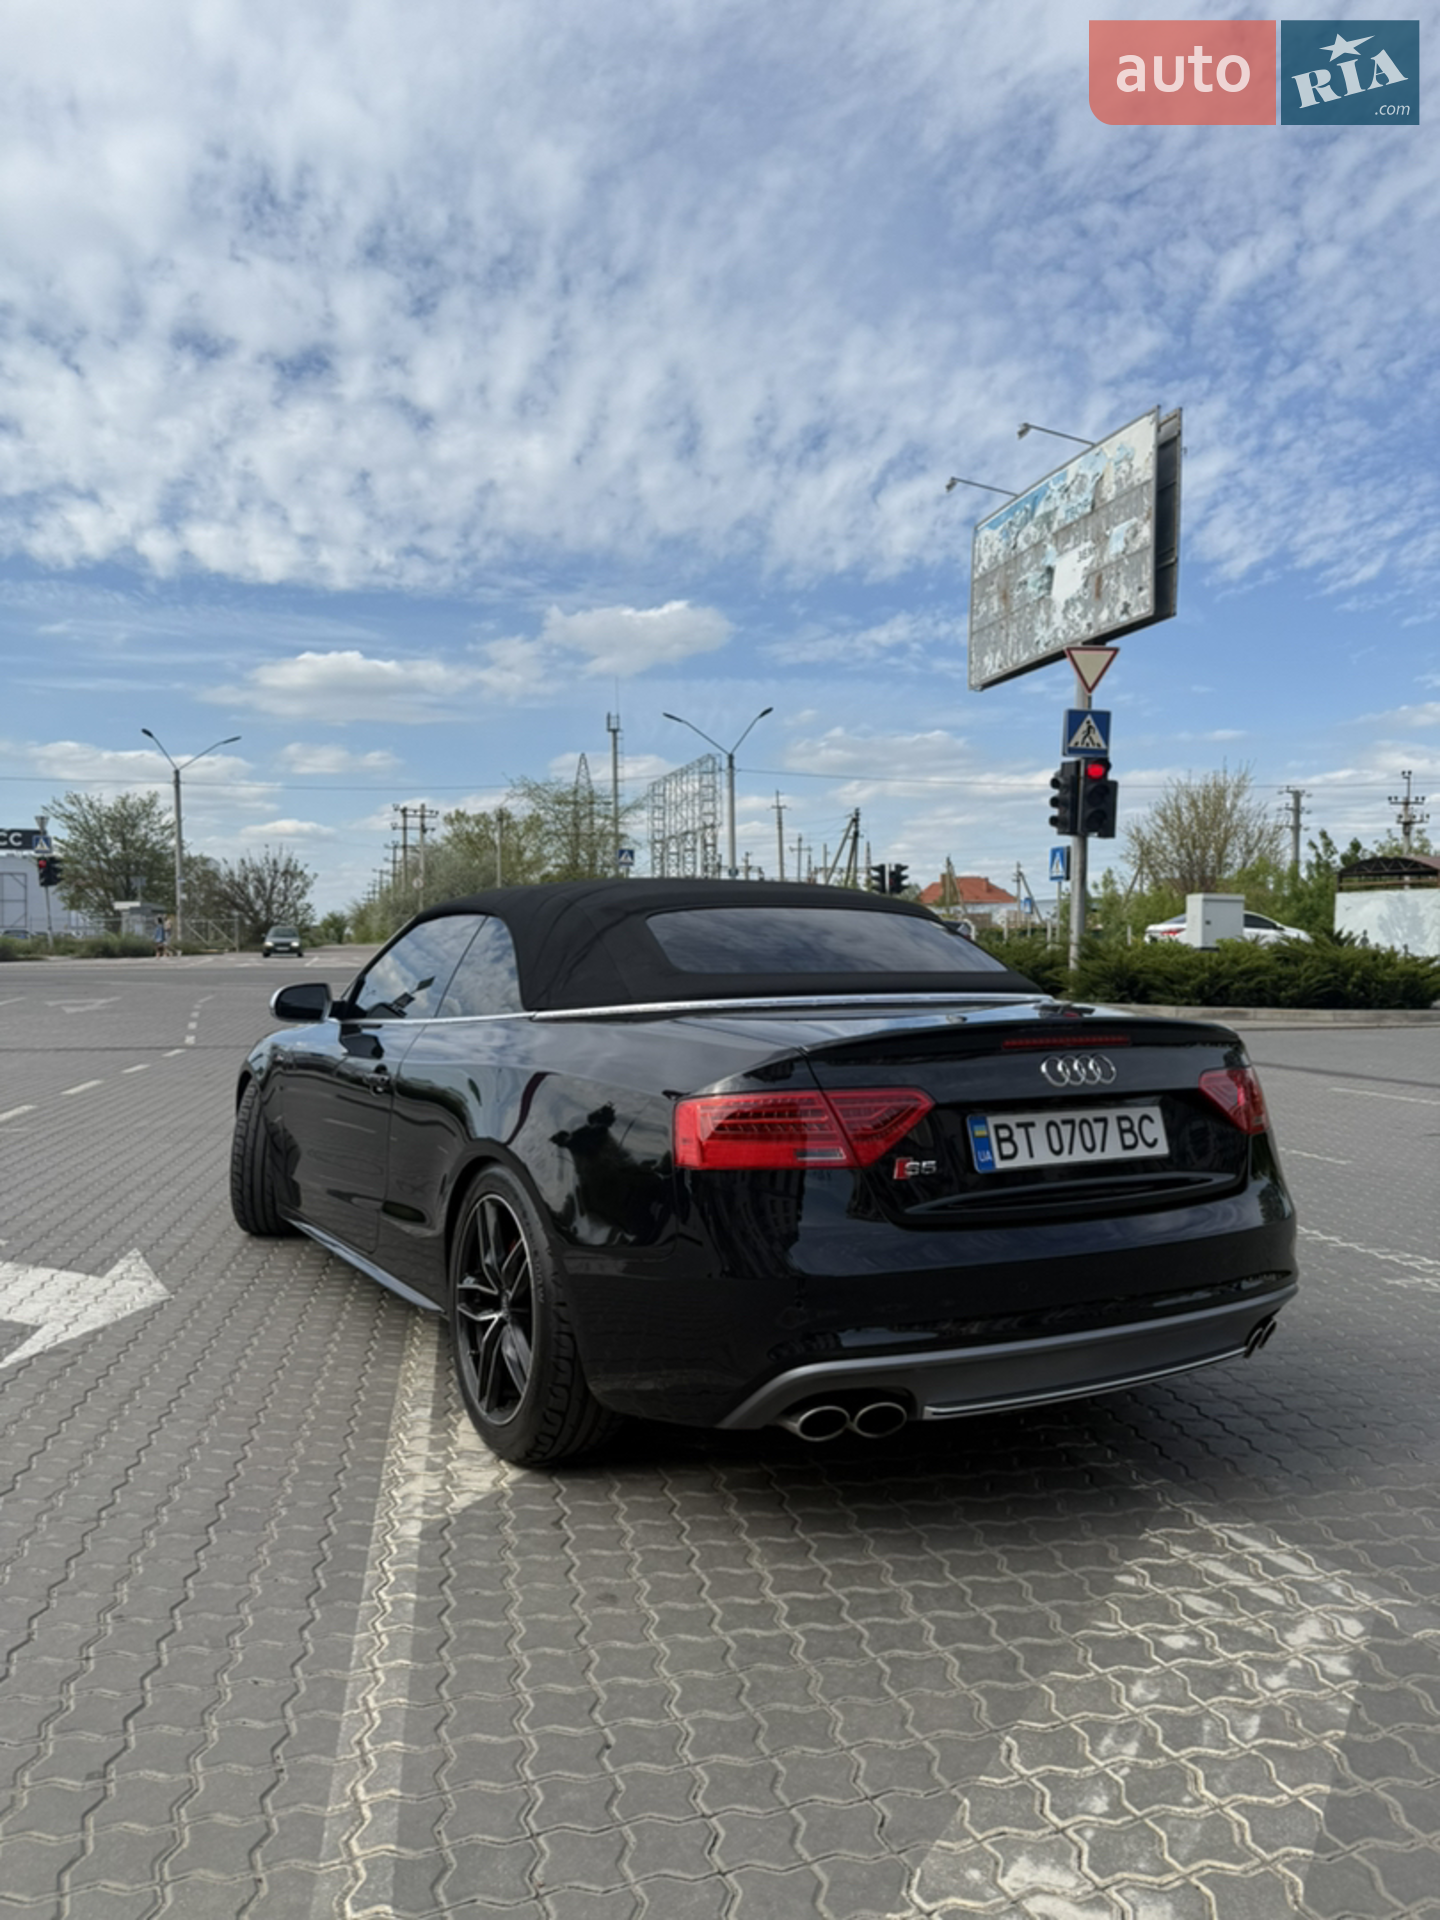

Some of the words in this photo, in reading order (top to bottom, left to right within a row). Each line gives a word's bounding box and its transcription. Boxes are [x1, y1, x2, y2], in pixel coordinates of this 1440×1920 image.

[993, 1121, 1036, 1161] BT
[1045, 1117, 1109, 1156] 0707
[1116, 1114, 1159, 1150] BC
[978, 1150, 993, 1162] UA
